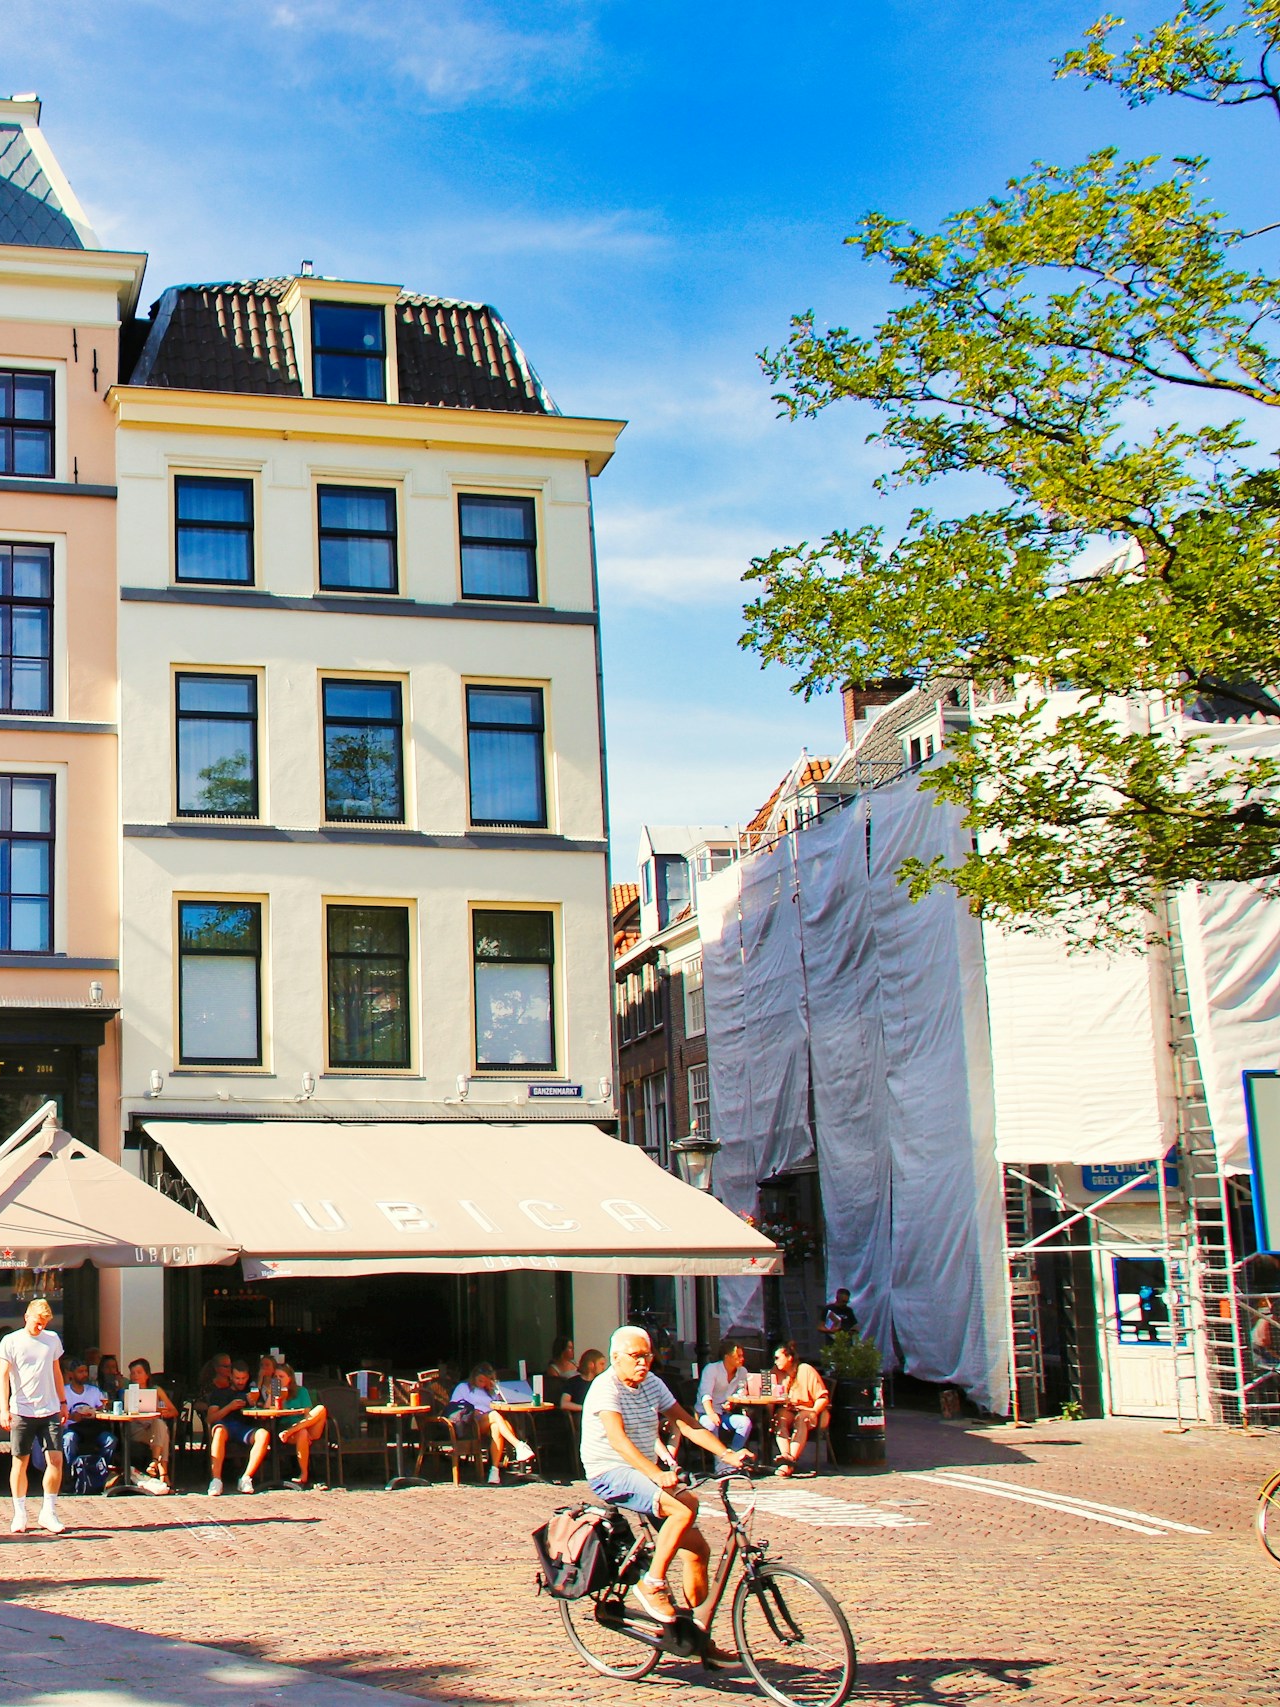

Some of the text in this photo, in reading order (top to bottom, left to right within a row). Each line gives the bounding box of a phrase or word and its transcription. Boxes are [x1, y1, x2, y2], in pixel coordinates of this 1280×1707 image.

[36, 1064, 53, 1073] 2014
[533, 1087, 578, 1096] GANZENMARKT
[1092, 1175, 1119, 1186] GREEK
[291, 1198, 674, 1234] UBICA
[135, 1246, 195, 1263] UBICA
[481, 1255, 560, 1269] UBICA
